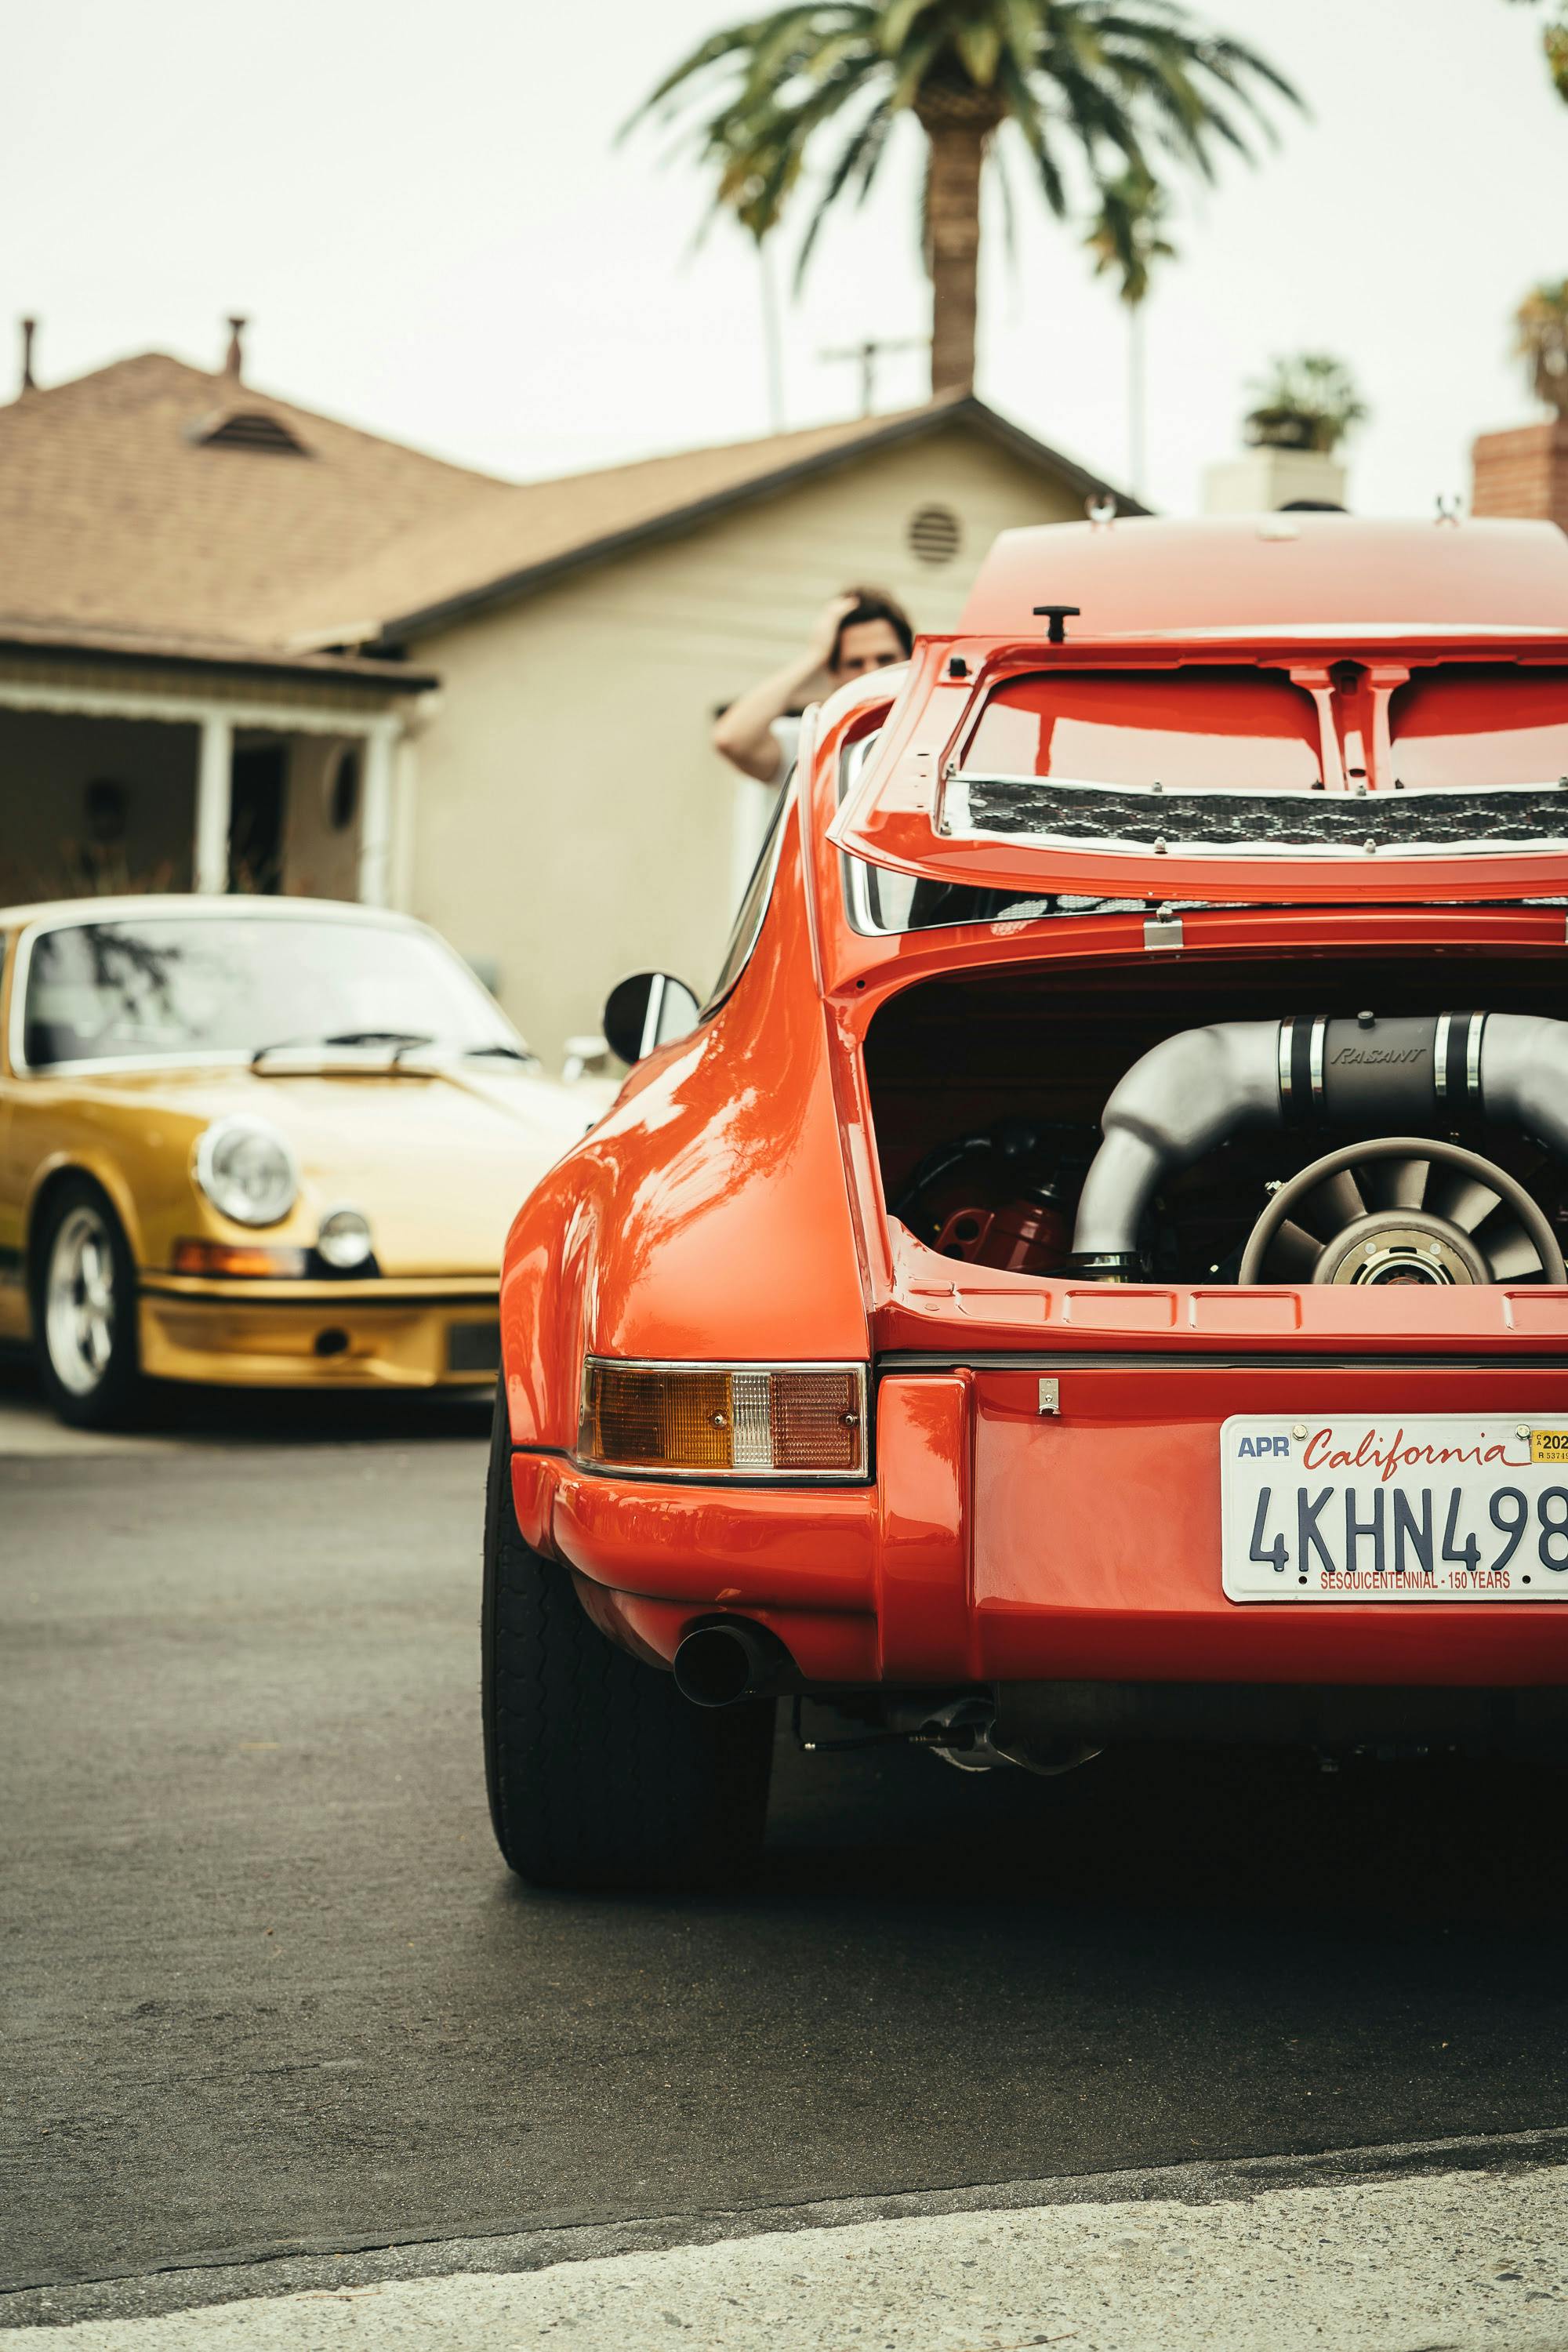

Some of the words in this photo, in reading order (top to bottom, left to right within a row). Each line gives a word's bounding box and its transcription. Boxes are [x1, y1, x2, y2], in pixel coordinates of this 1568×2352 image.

[1330, 1047, 1427, 1065] RASANT
[1238, 1436, 1290, 1457] APR
[1543, 1435, 1568, 1449] 202
[1303, 1428, 1533, 1482] California
[1249, 1486, 1568, 1572] 4KHN498
[1320, 1570, 1438, 1589] SESQUICENTENNIAL
[1448, 1571, 1467, 1588] 150
[1470, 1571, 1511, 1589] YEARS
